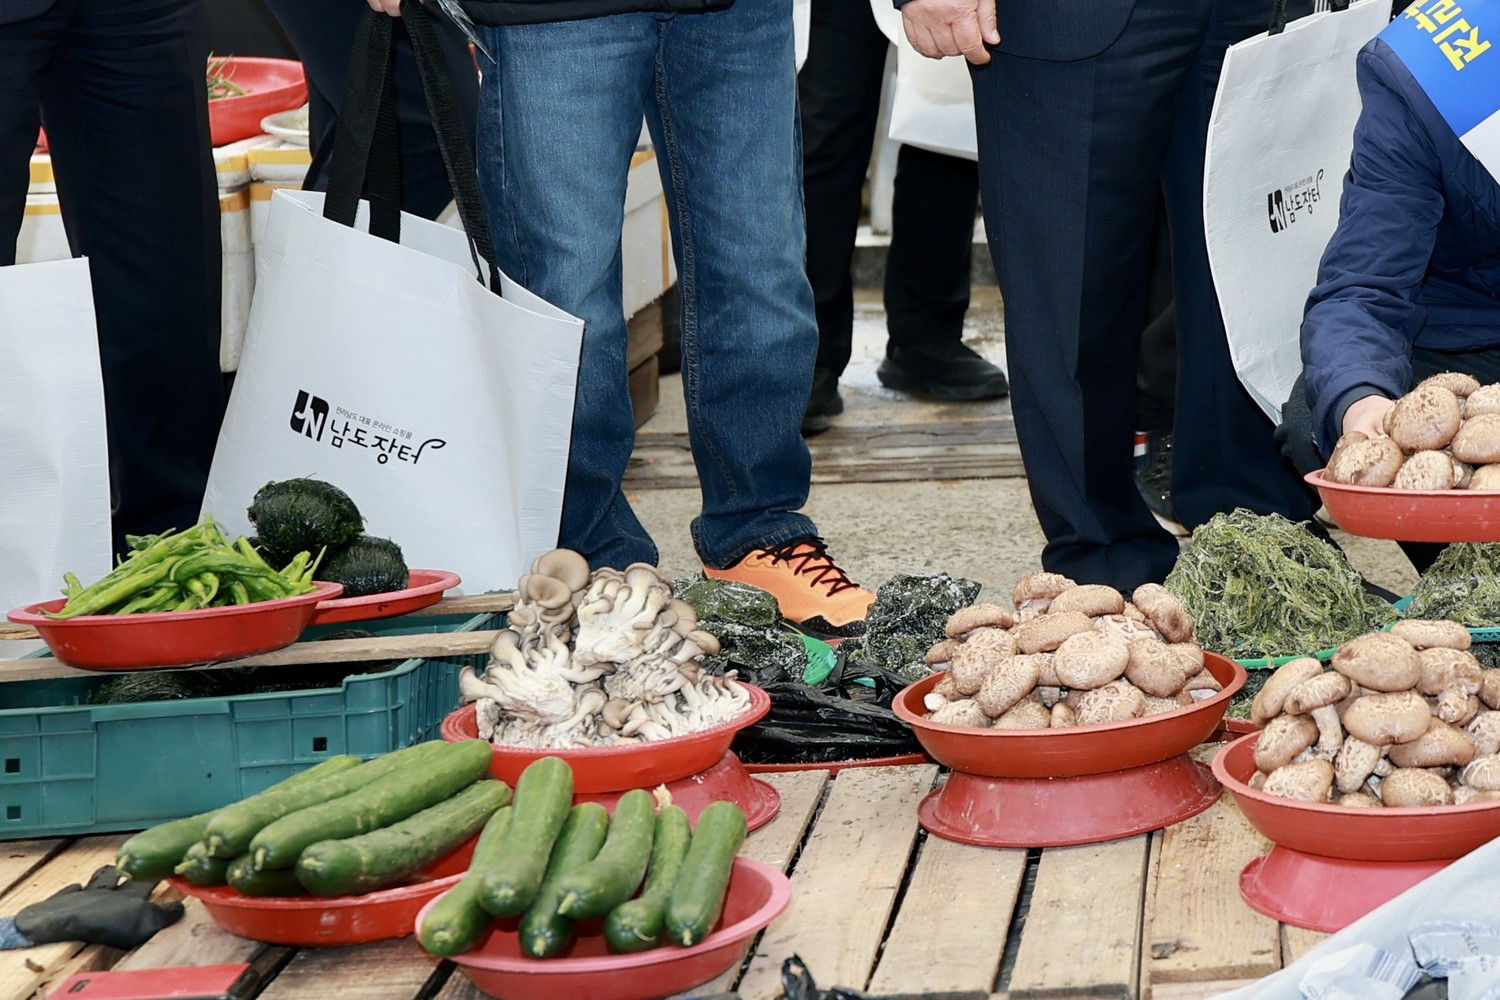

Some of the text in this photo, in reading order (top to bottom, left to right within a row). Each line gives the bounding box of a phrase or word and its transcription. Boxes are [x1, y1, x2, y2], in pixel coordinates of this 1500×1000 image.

[1284, 168, 1324, 224] 남도장터
[330, 419, 447, 465] 남도장터
[336, 406, 413, 440] 전라남도 대표 온라인 쇼핑몰
